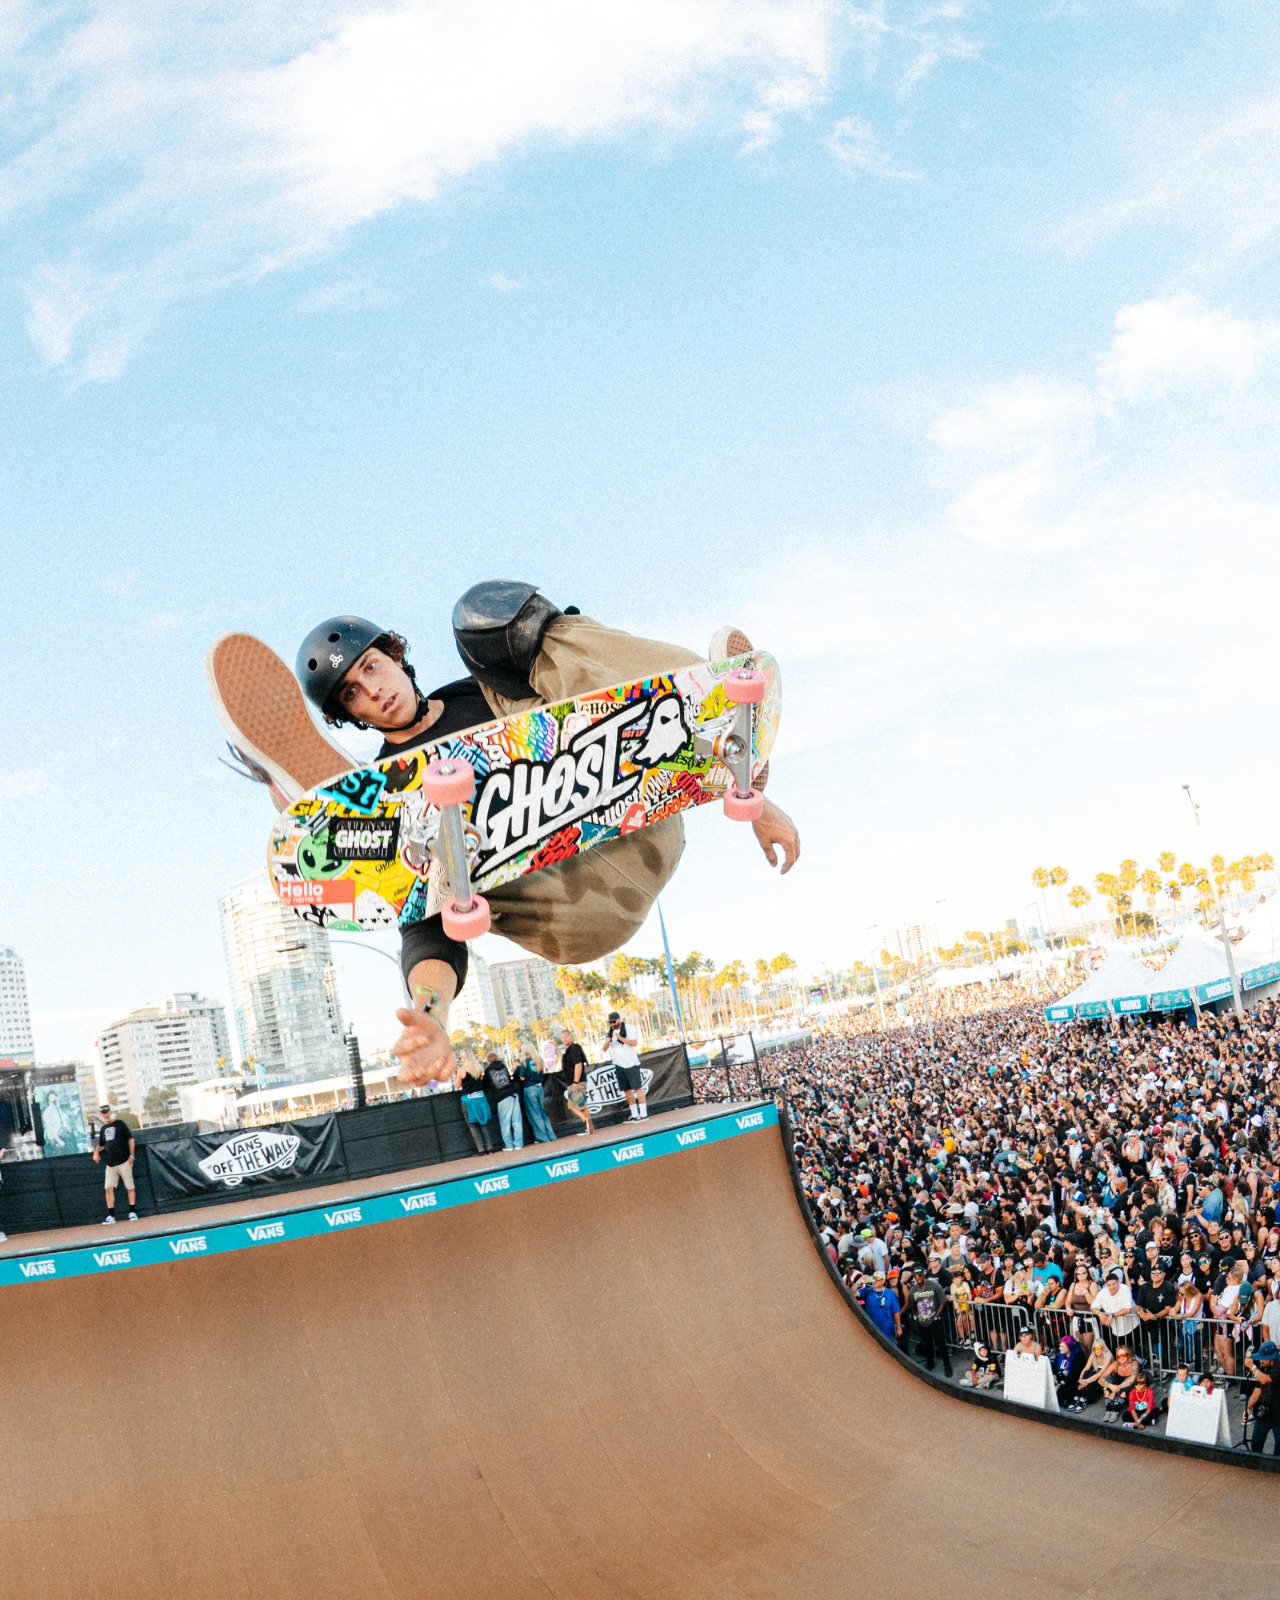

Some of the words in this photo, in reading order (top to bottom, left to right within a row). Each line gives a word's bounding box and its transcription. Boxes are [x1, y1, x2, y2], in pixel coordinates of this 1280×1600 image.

[474, 700, 648, 877] GHOST
[335, 829, 392, 849] GHOST
[279, 881, 324, 897] Hello
[597, 1081, 622, 1101] THE
[736, 1112, 764, 1129] VANS
[226, 1134, 262, 1156] VANS
[676, 1128, 706, 1146] VANS
[235, 1151, 263, 1172] THE
[612, 1143, 645, 1162] VANS
[545, 1159, 580, 1178] VANS
[474, 1175, 510, 1194] VANS
[400, 1192, 437, 1211] VANS
[325, 1207, 362, 1226] VANS
[247, 1222, 285, 1241] VANS
[169, 1236, 207, 1255] VANS
[94, 1249, 131, 1267] VANS
[19, 1260, 56, 1277] VANS
